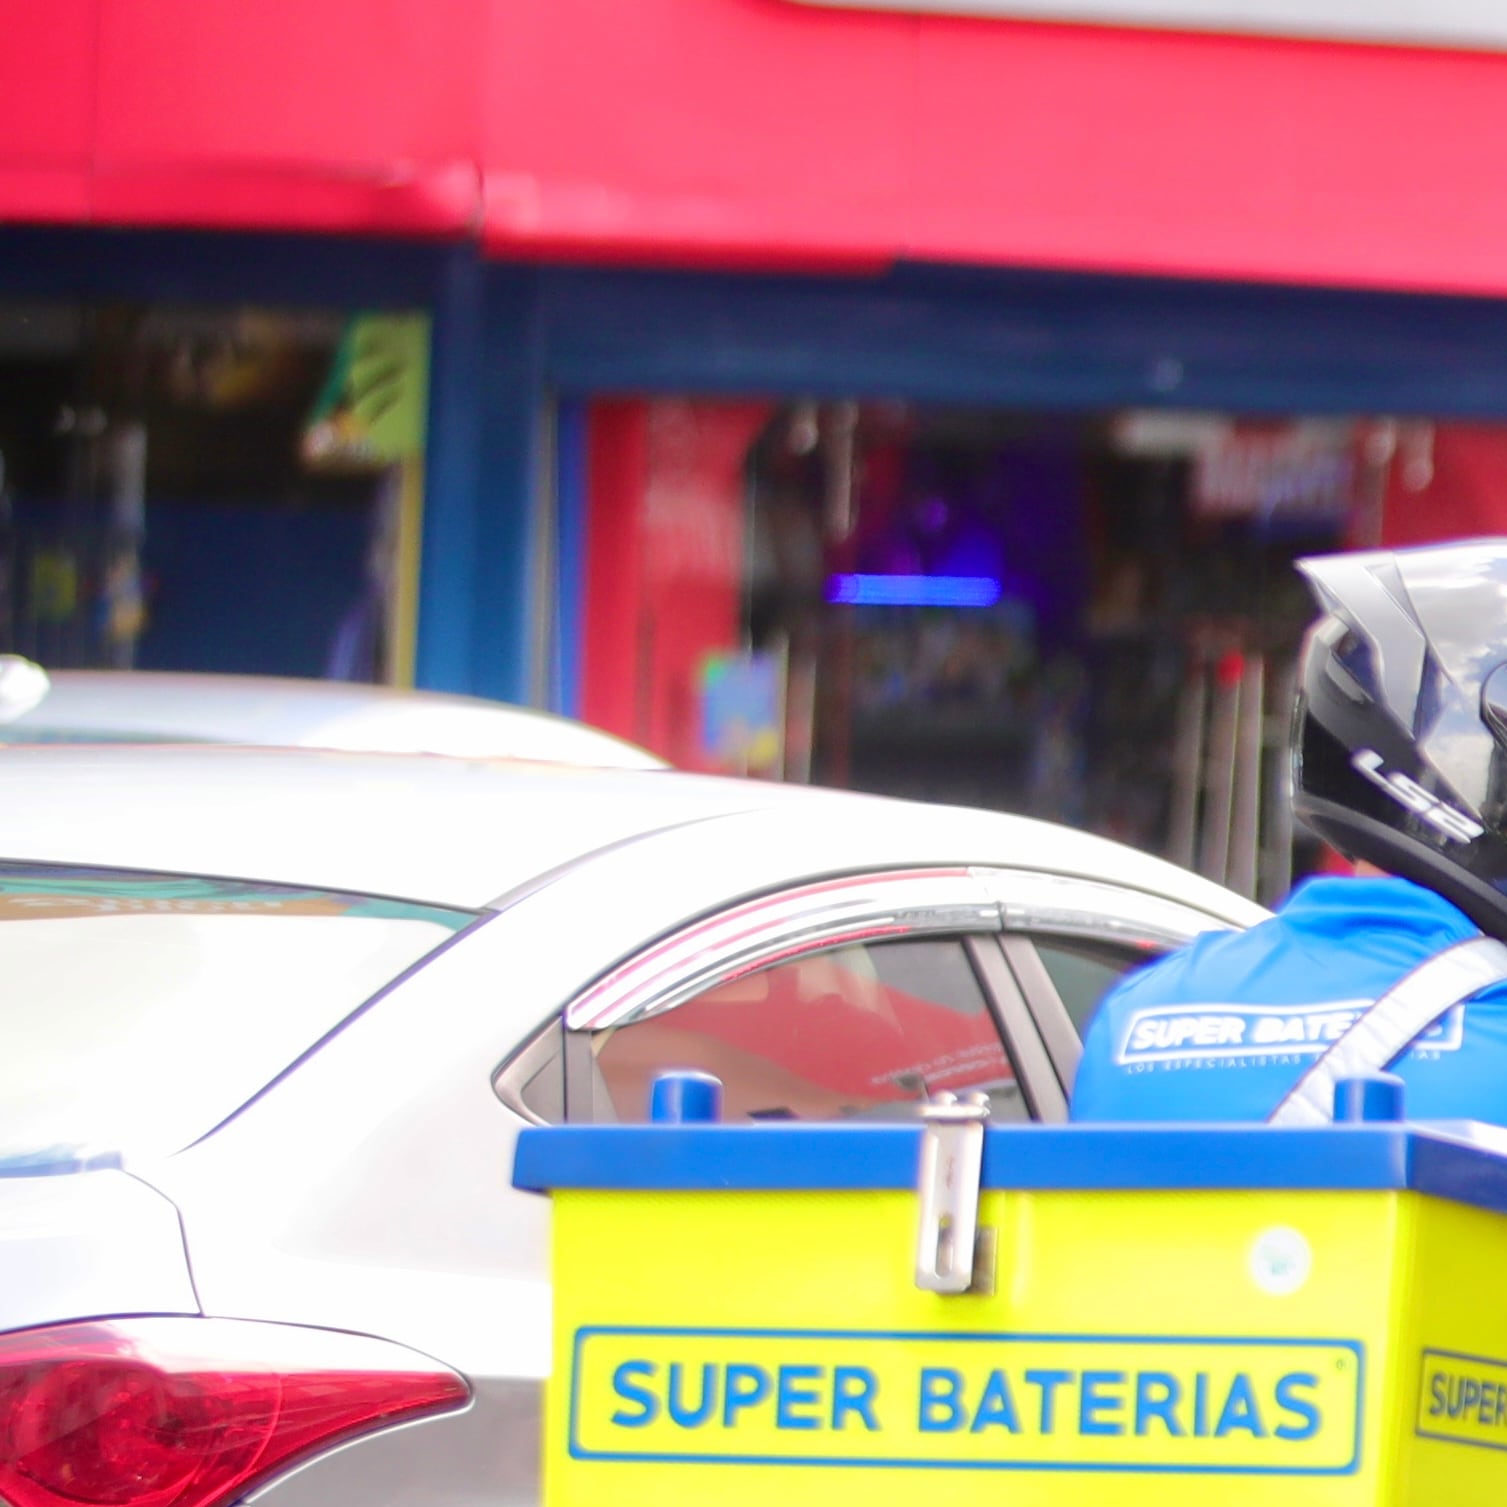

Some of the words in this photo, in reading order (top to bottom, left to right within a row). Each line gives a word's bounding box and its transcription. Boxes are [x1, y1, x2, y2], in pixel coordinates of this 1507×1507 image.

[1351, 748, 1485, 844] LS2
[1132, 1016, 1247, 1051] SUPER
[609, 1358, 880, 1434] SUPER
[917, 1366, 1323, 1443] BATERIAS
